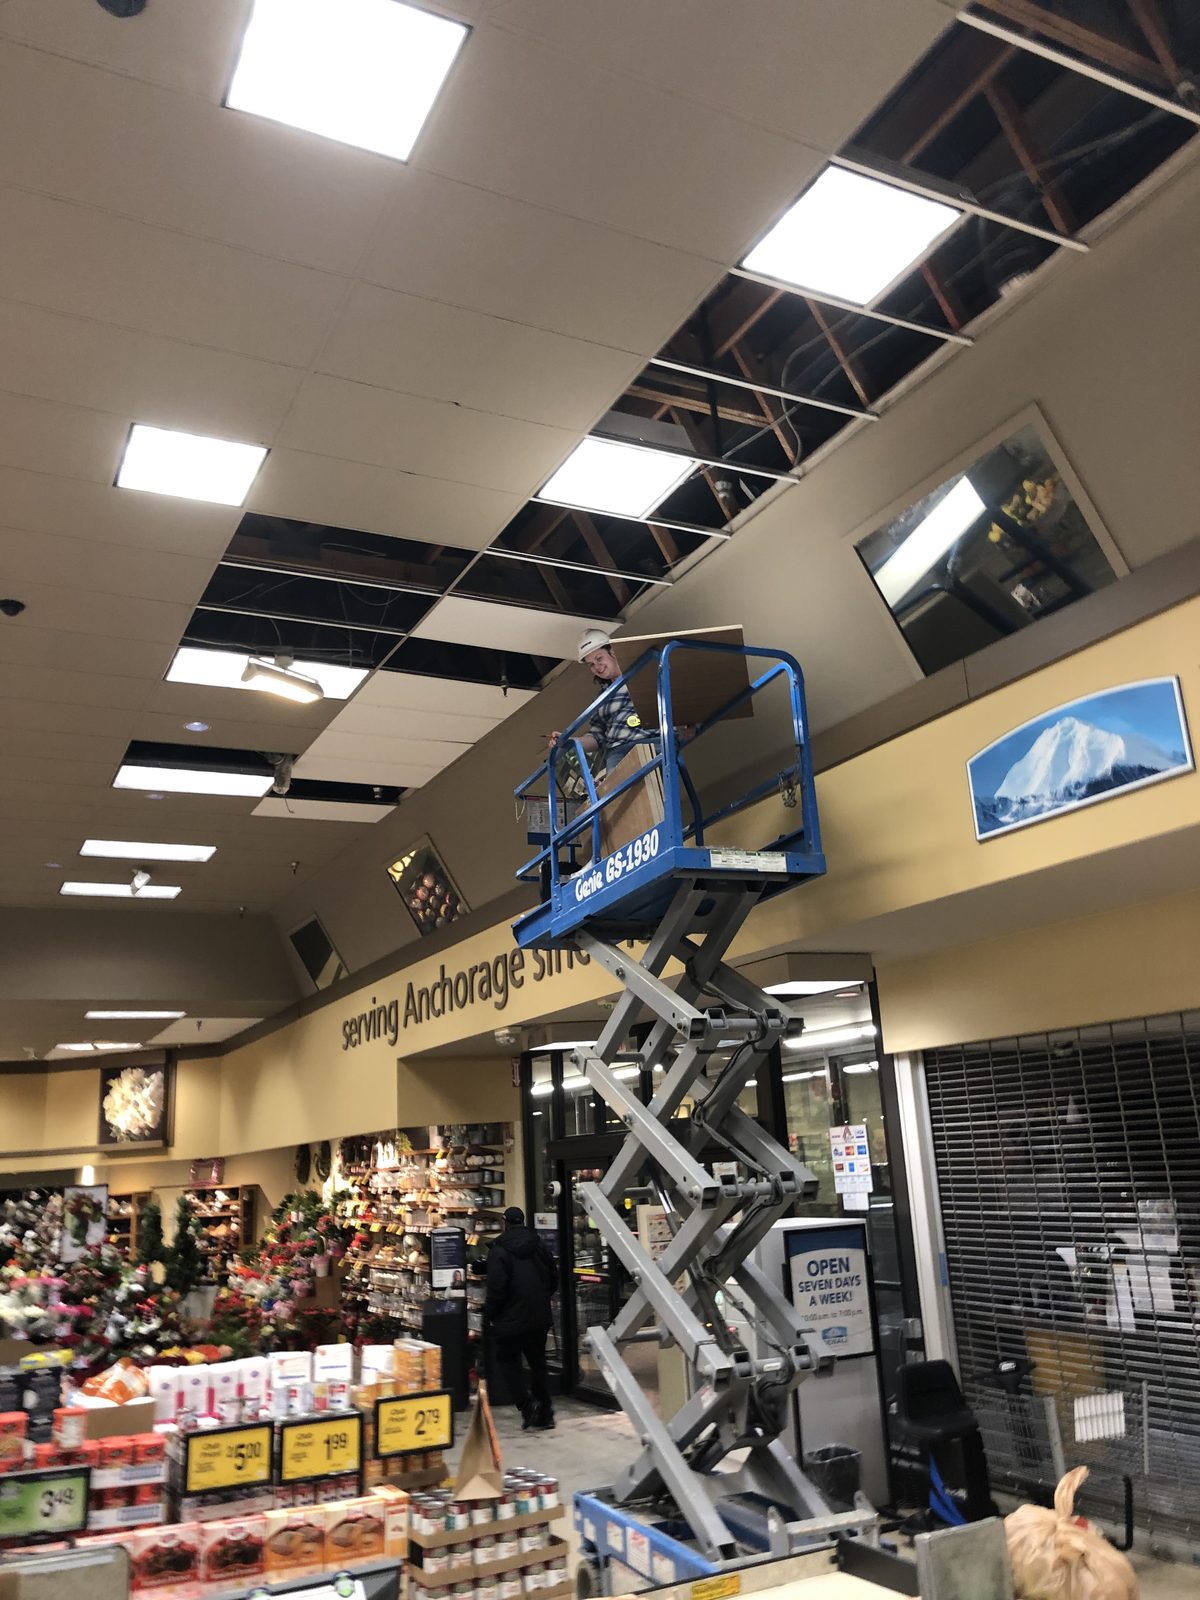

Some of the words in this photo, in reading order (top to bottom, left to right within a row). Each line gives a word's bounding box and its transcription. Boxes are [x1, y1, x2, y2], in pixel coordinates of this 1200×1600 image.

[575, 870, 604, 901] Genie
[606, 829, 659, 883] GS-1930
[341, 997, 398, 1050] serving
[403, 948, 525, 1028] Anchorage
[533, 949, 591, 982] sin
[807, 1257, 850, 1277] OPEN
[798, 1279, 832, 1293] SEVEN
[835, 1275, 861, 1289] DAYS
[809, 1296, 817, 1306] A
[820, 1291, 853, 1305] WEEK!
